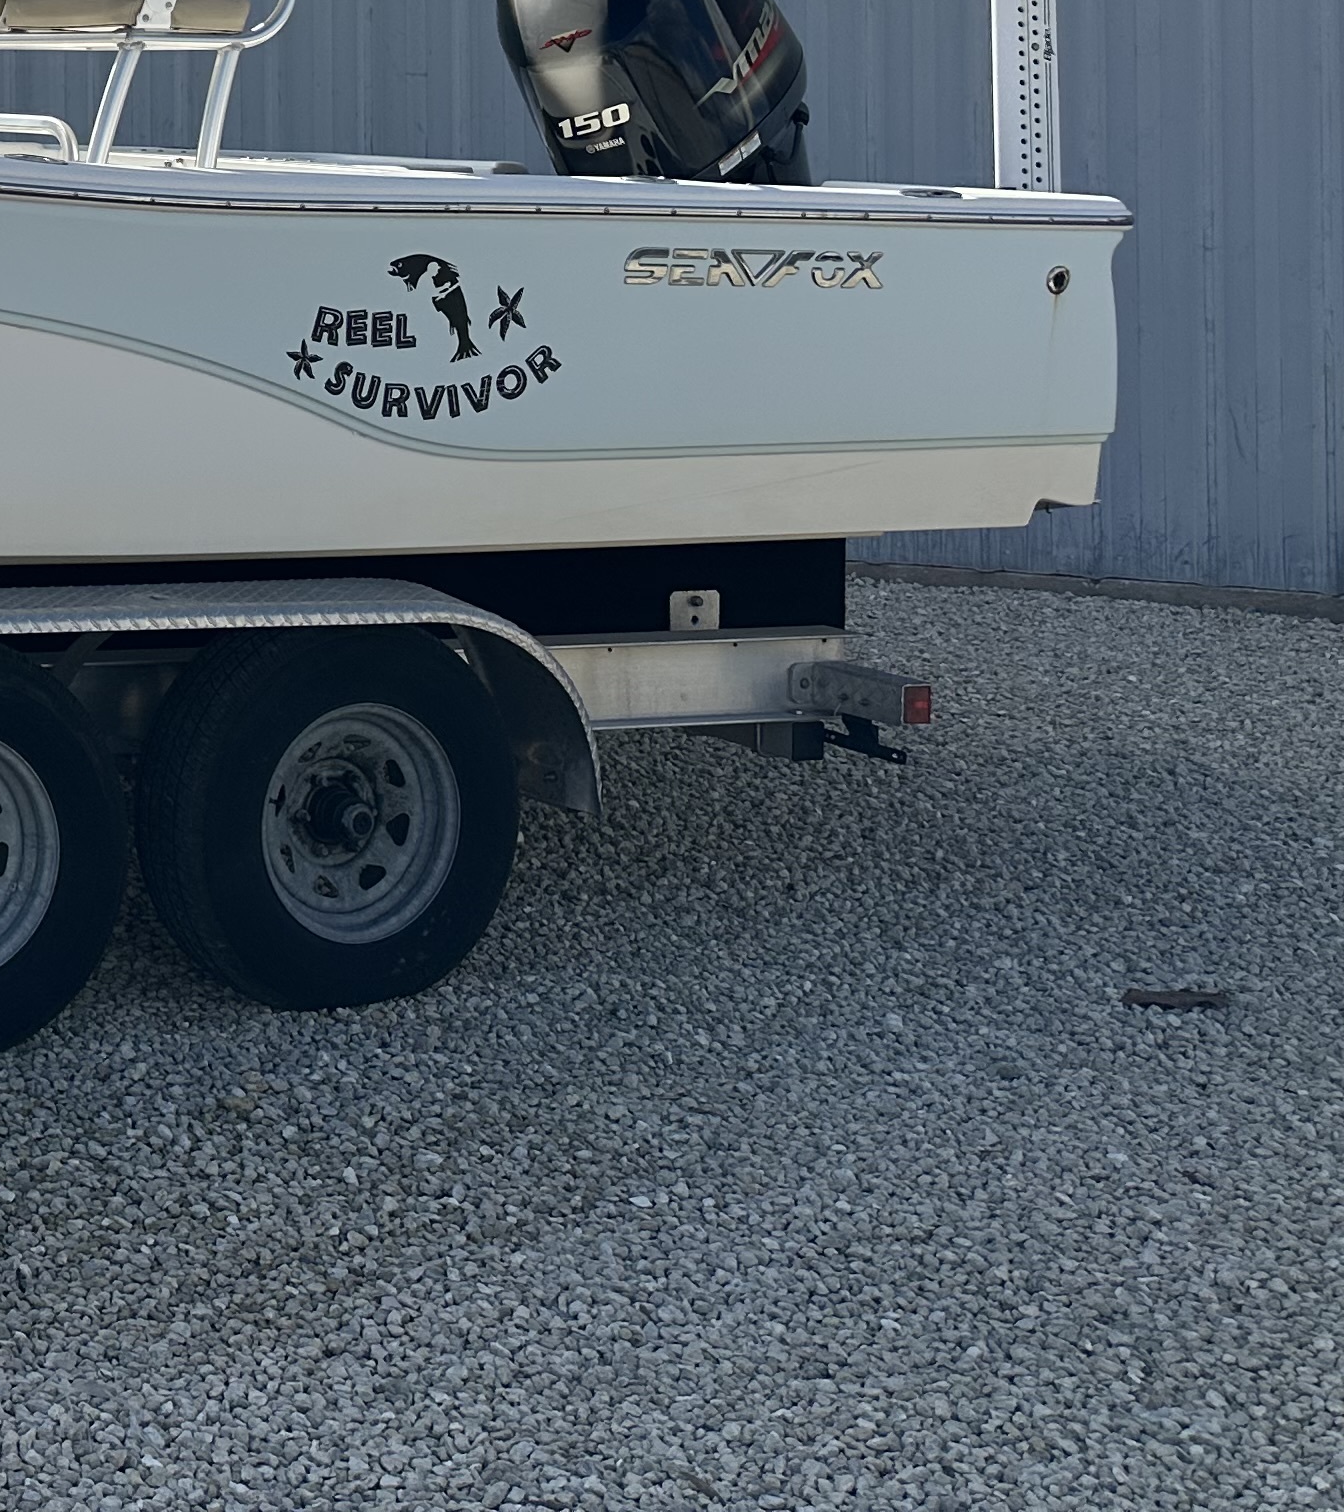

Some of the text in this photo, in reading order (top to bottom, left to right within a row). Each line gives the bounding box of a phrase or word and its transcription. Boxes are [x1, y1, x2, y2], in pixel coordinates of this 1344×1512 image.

[558, 103, 630, 138] 150
[594, 136, 626, 151] YAMAHA
[311, 305, 417, 349] REEL
[324, 344, 562, 421] SURVIVOR
